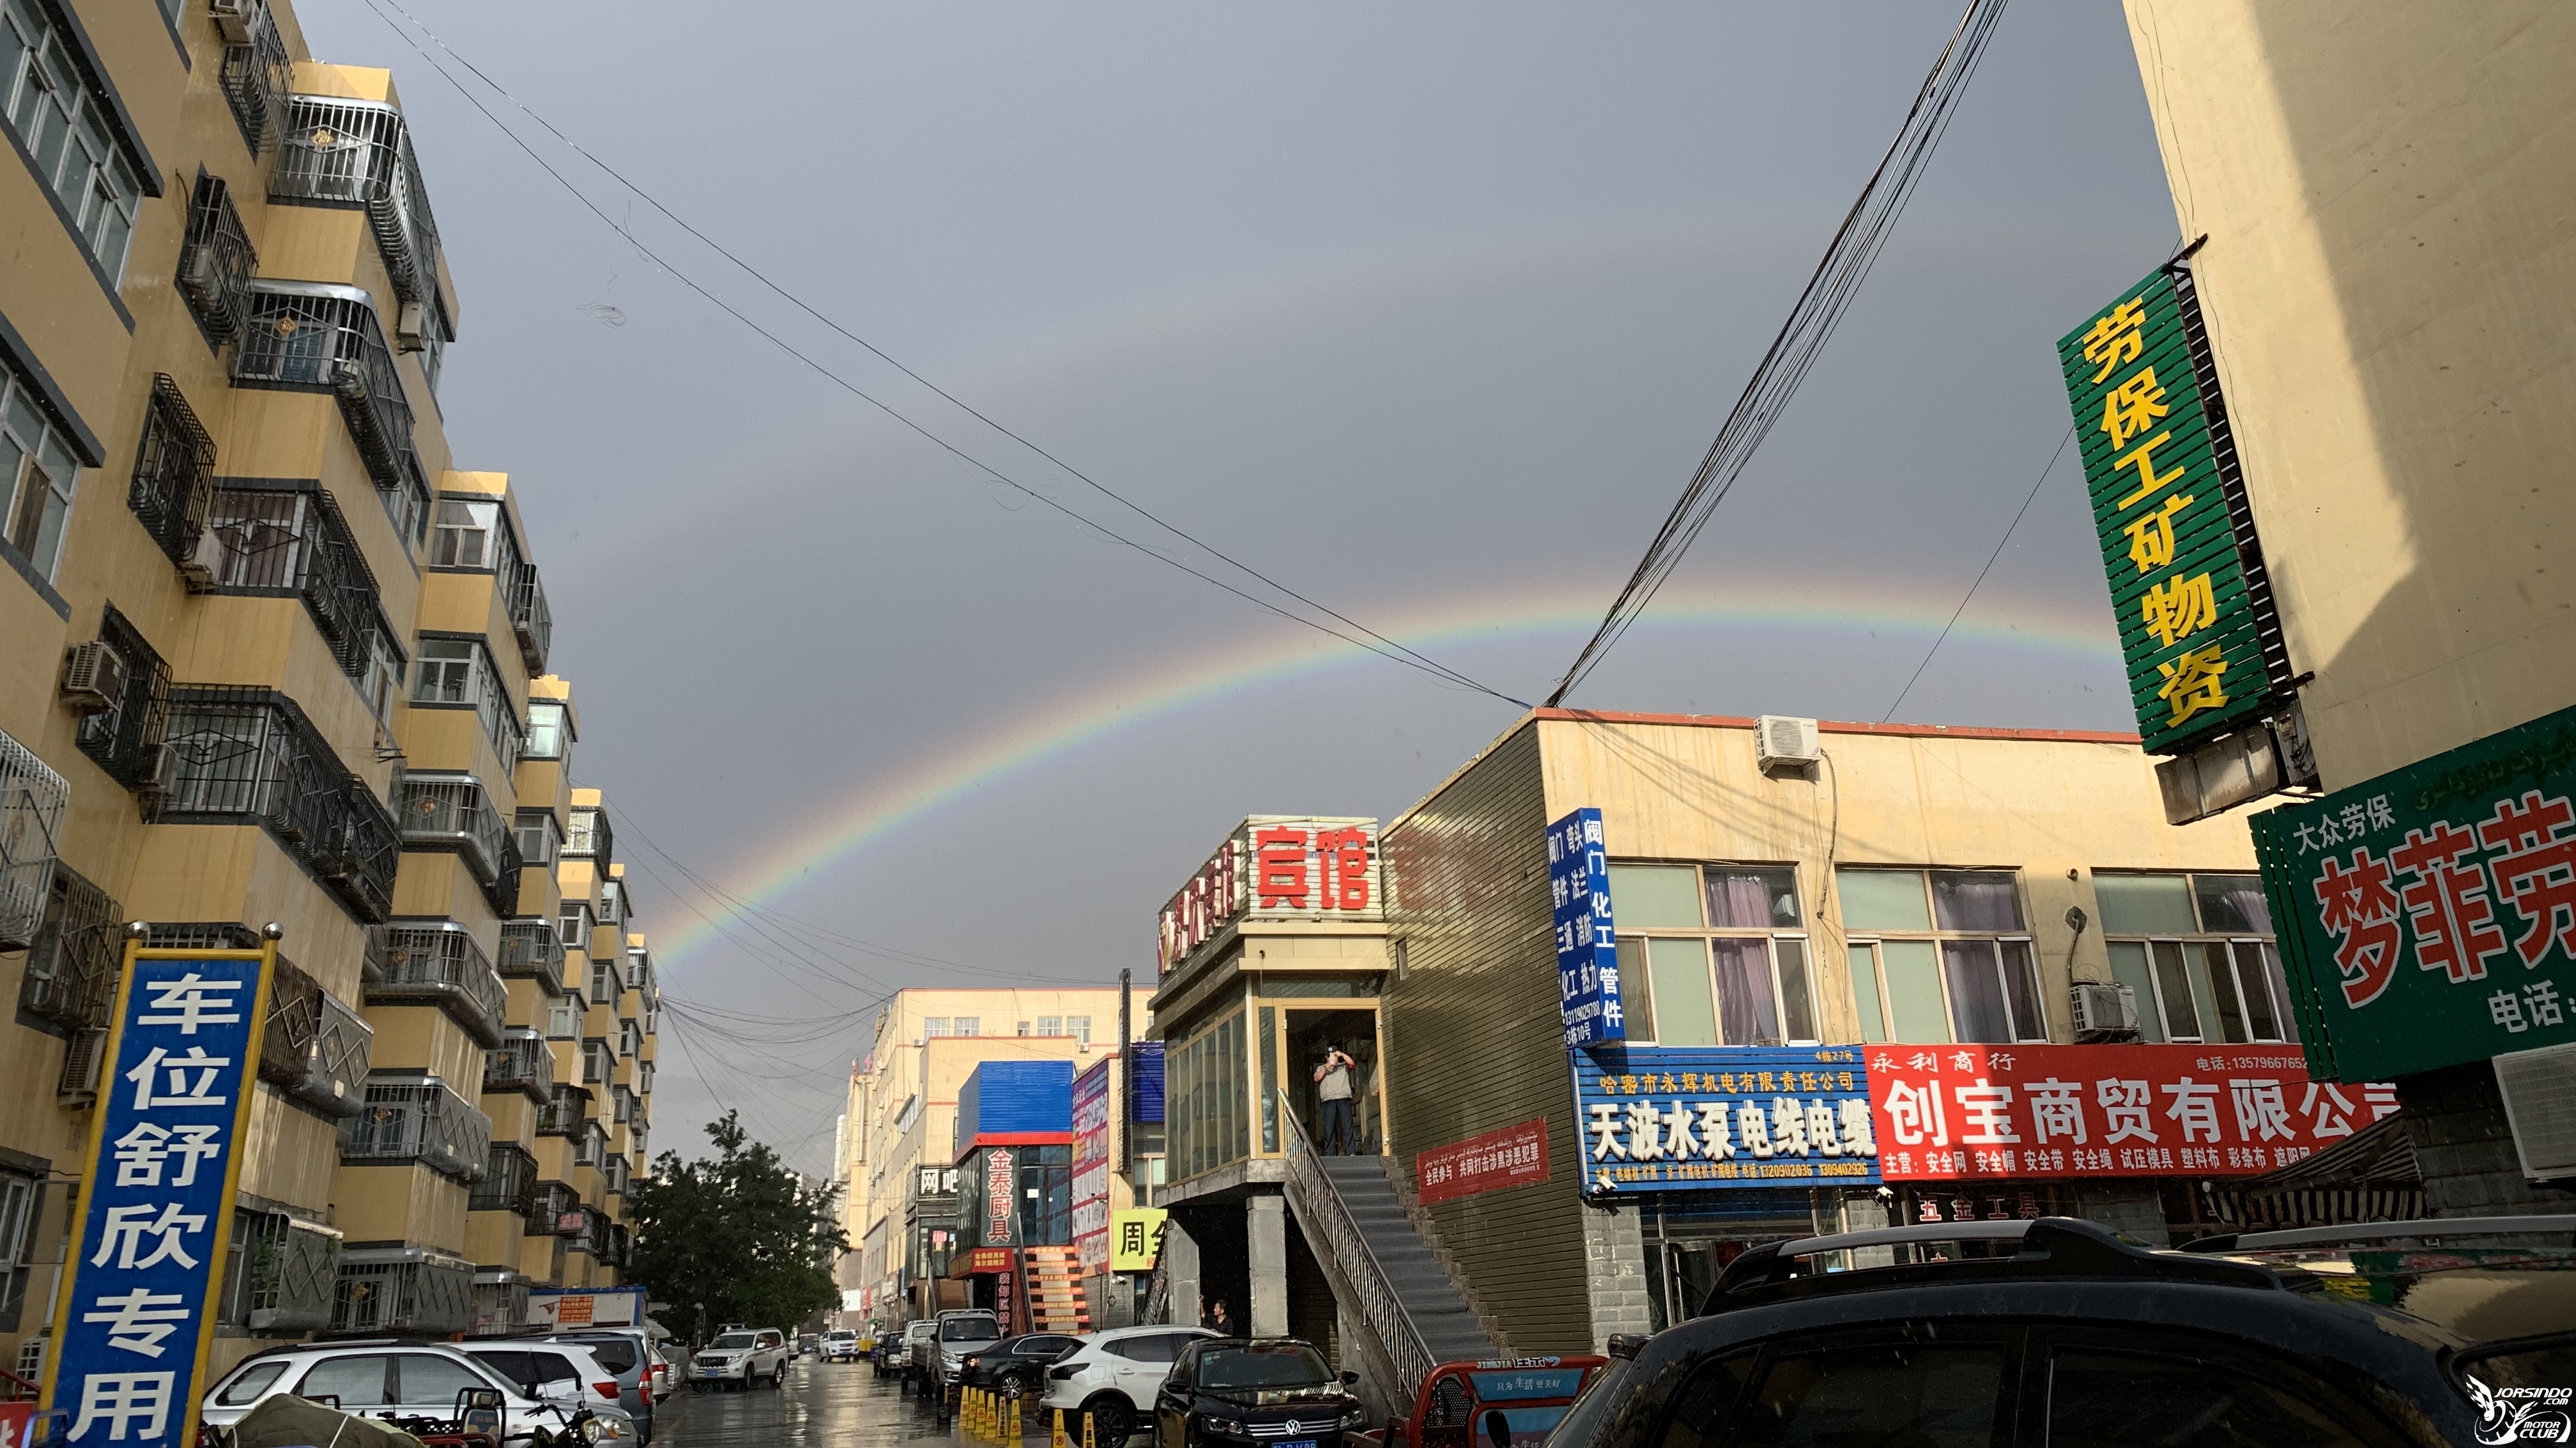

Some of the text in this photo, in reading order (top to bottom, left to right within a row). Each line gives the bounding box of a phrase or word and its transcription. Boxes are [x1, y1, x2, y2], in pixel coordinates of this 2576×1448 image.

[2083, 296, 2230, 728] 劳保工矿物资
[1566, 819, 1583, 855] 弯头
[2293, 794, 2396, 857] 大众劳保
[1256, 825, 1370, 910] 宾馆
[1552, 865, 1588, 910] 管件 法兰
[2313, 789, 2576, 1009] 梦菲劳
[1561, 959, 1598, 1002] 化工 热力
[1564, 1000, 1600, 1026] 13119029788
[1566, 1021, 1591, 1046] 3栋10号
[1600, 1070, 1854, 1095] 哈密市永辉机电有限责任公司
[1871, 1050, 2017, 1074] 永利商行
[1589, 1095, 1877, 1162] 天波水泵电线电缆
[921, 1169, 958, 1194] 网吧
[1425, 1164, 1453, 1186] 全民参与
[1459, 1142, 1539, 1178] 共同打击涉黑涉恶犯罪
[1925, 1150, 1968, 1173] 安全网
[1975, 1149, 2016, 1173] 安全帽
[2023, 1148, 2064, 1171] 安全带
[2180, 1147, 2220, 1170] 塑料布
[66, 973, 241, 1442] 车位舒欣专用
[987, 1147, 1013, 1243] 金泰厨具
[1918, 1192, 2040, 1221] 五金工具
